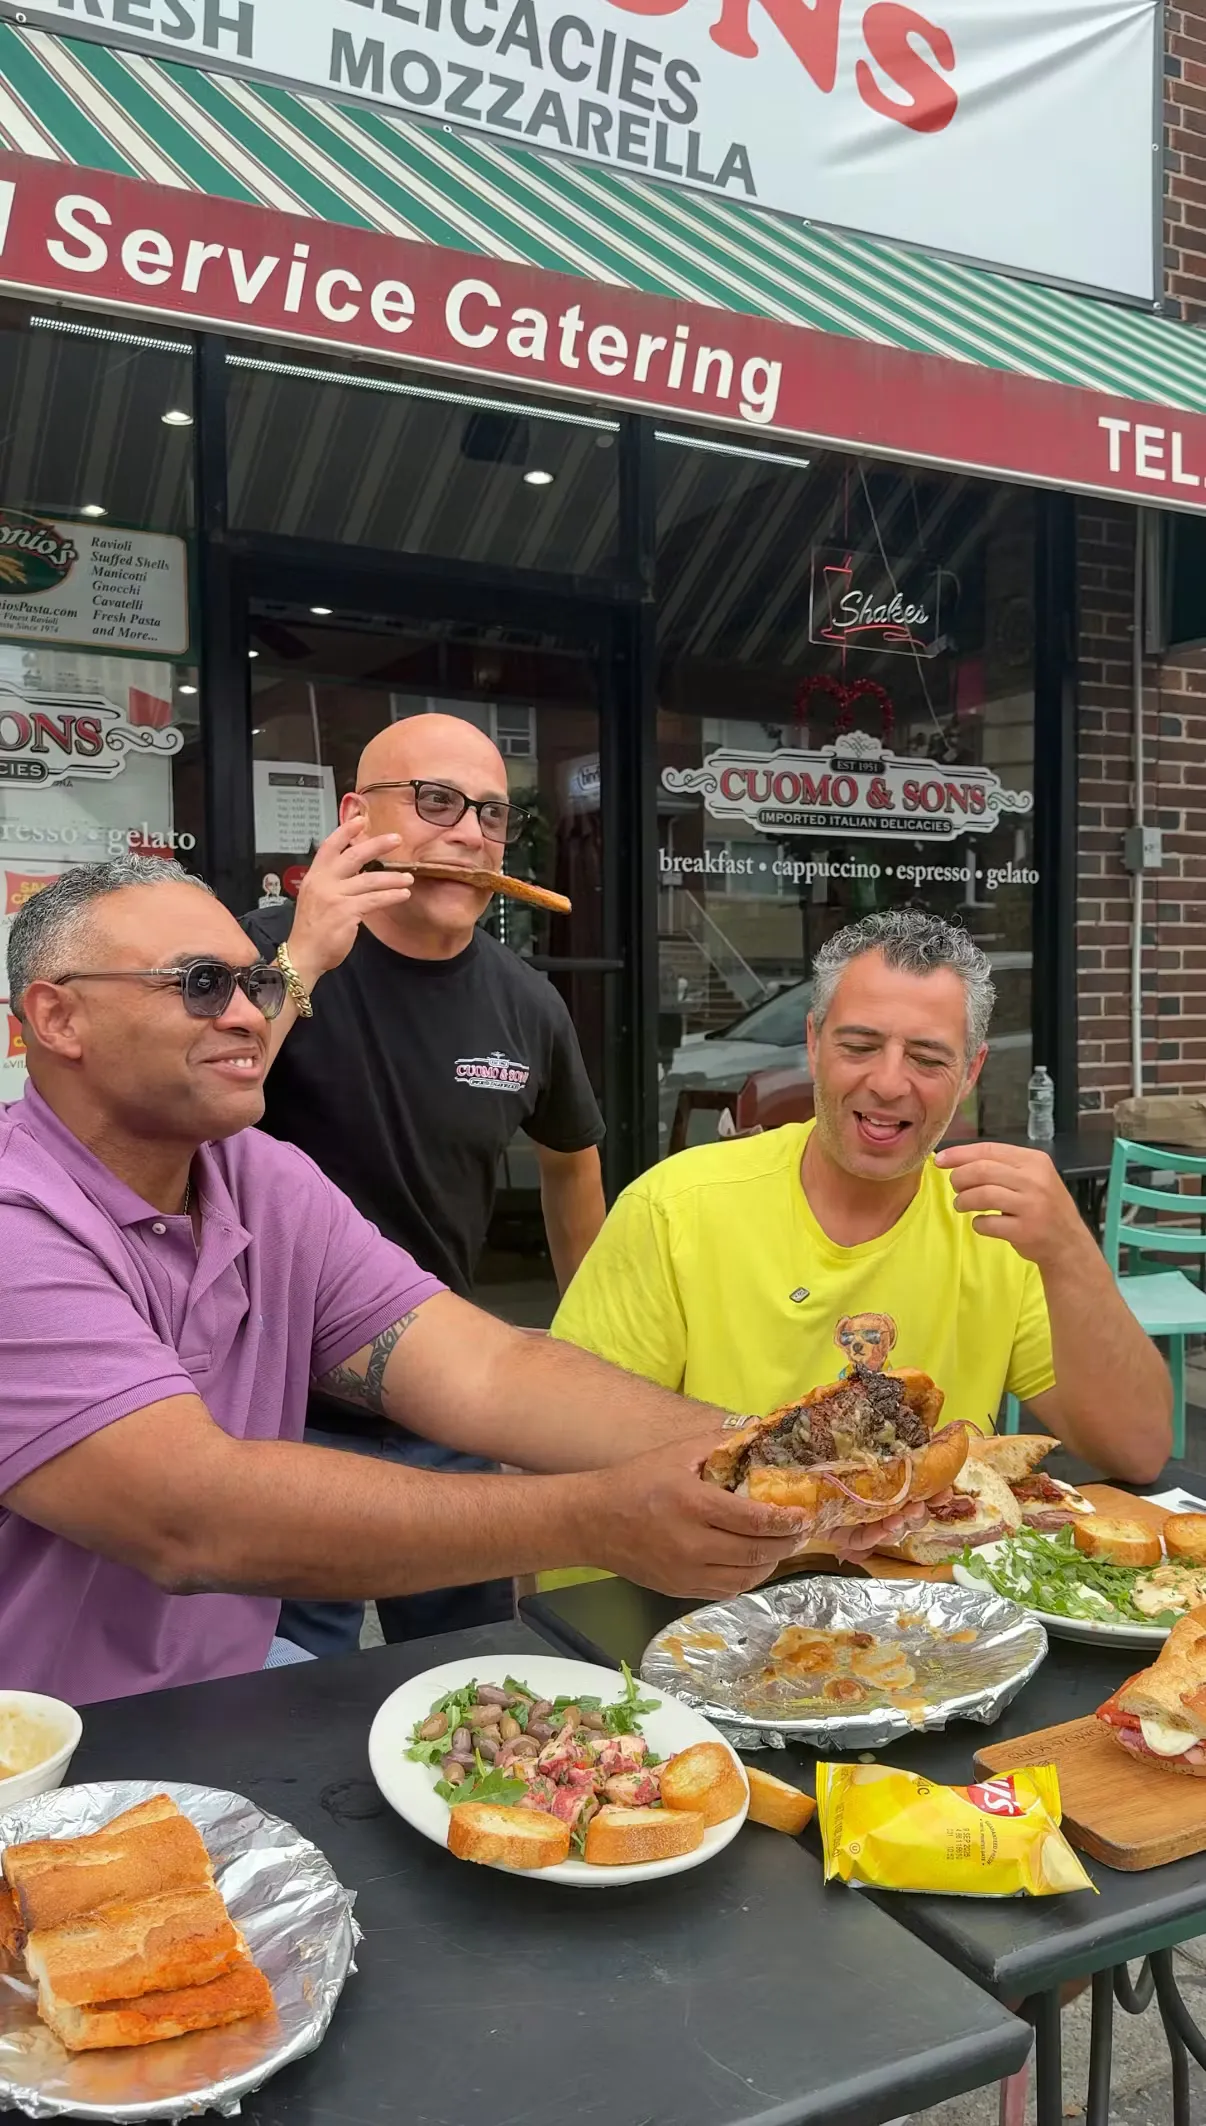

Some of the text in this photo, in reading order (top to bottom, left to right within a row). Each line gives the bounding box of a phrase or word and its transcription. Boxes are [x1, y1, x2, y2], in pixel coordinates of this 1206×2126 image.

[345, 0, 701, 125] ICACIES
[607, 0, 957, 133] NS
[329, 28, 757, 196] MOZZARELLA
[46, 195, 415, 333] Service
[445, 279, 782, 424] Catering
[1098, 416, 1206, 488] TEL
[91, 537, 132, 551] Ravioli
[91, 551, 169, 570] Stuffed Shells
[91, 565, 148, 582] Manicotti
[92, 580, 141, 595] Gnocchi
[92, 595, 143, 611] Cavatelli
[832, 590, 929, 627] Shakes
[93, 610, 161, 627] Fresh Pasta
[92, 626, 158, 641] and More...
[837, 760, 878, 772] EST 1951
[719, 768, 986, 815] CUOMO & SONS
[761, 812, 951, 831] IMPORTED ITALIAN DELICACIES
[108, 822, 196, 856] gelato
[658, 848, 1040, 889] breakfast cappuccino espresso gelato
[456, 1064, 499, 1079] CUOMO
